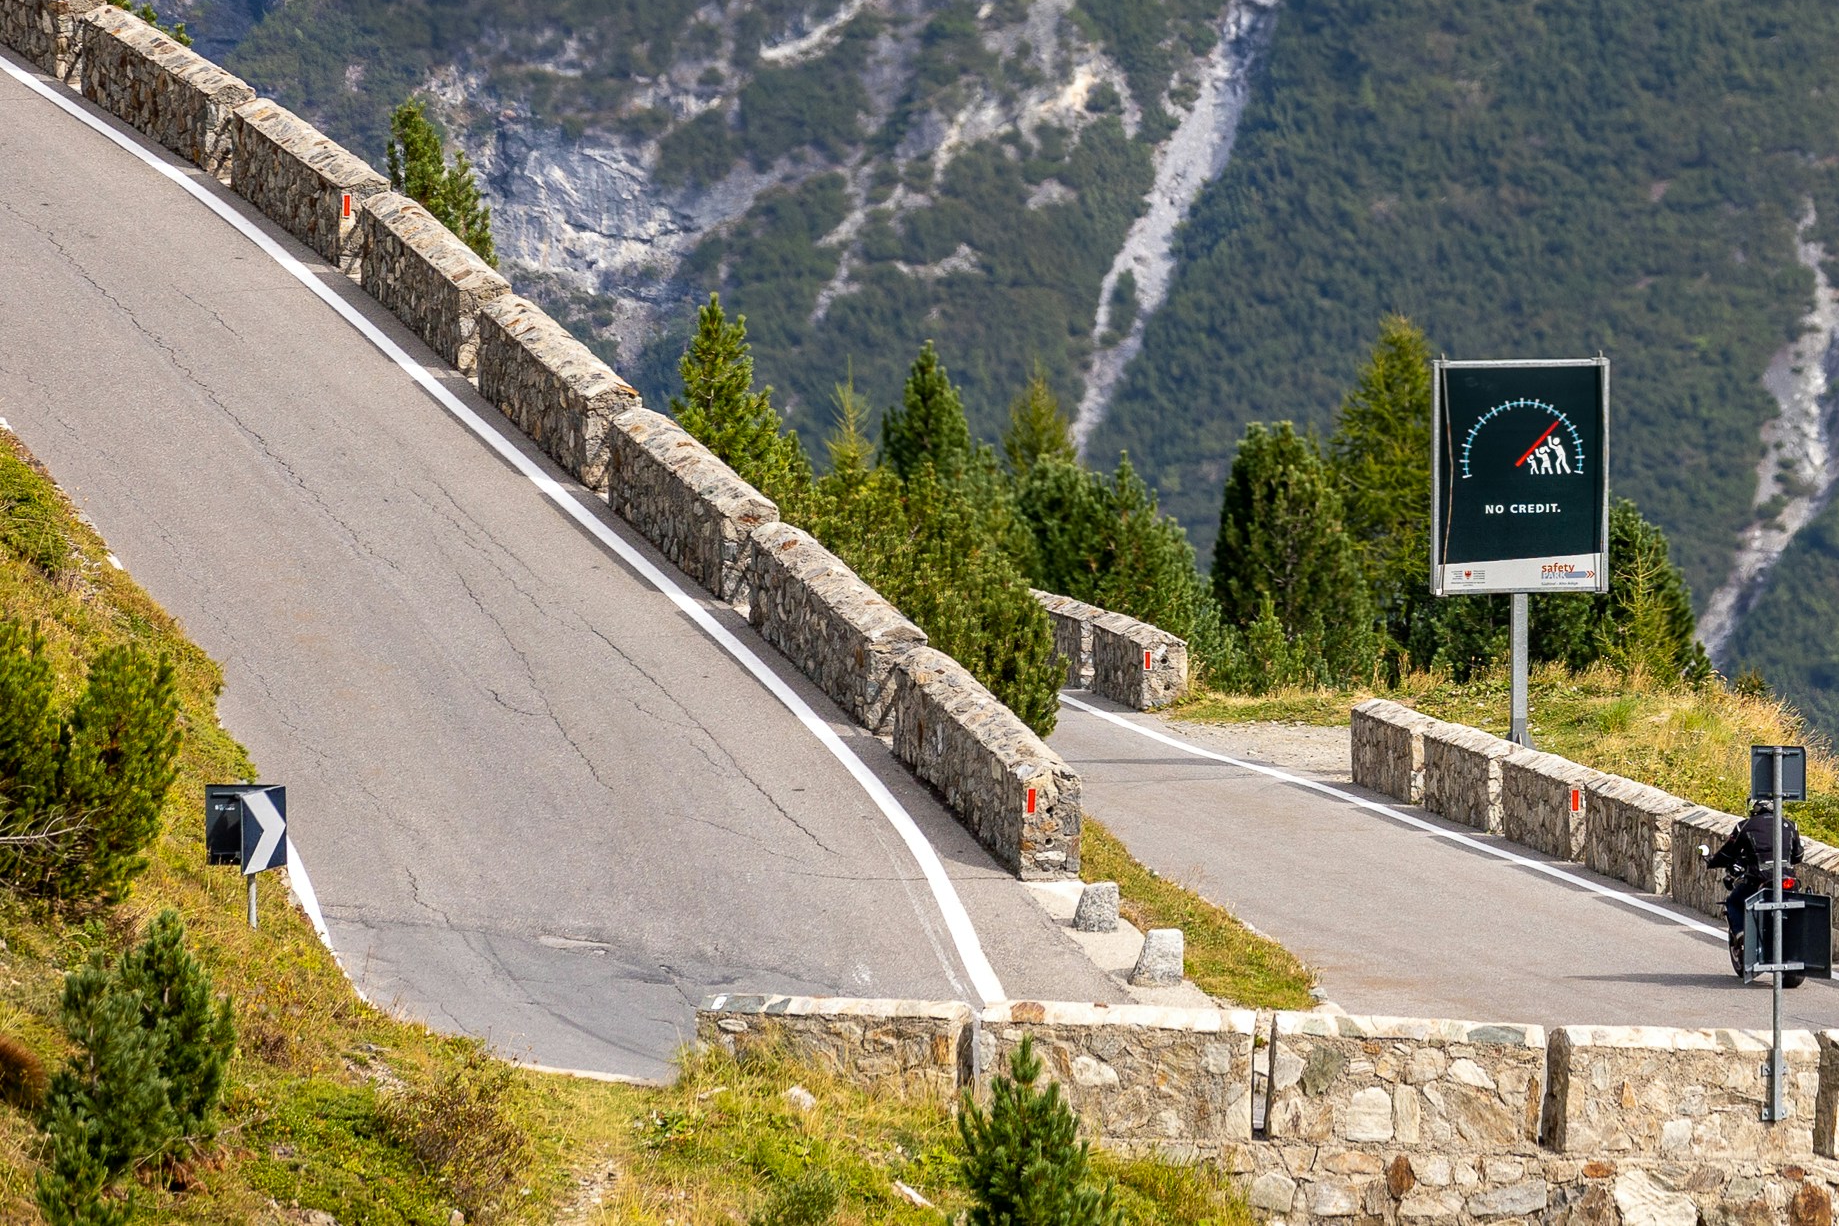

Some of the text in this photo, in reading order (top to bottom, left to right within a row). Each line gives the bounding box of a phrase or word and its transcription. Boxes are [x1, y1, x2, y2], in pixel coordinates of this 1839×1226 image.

[1485, 503, 1561, 514] NO CREDIT.
[1541, 562, 1575, 573] safety
[1541, 571, 1566, 579] PARK
